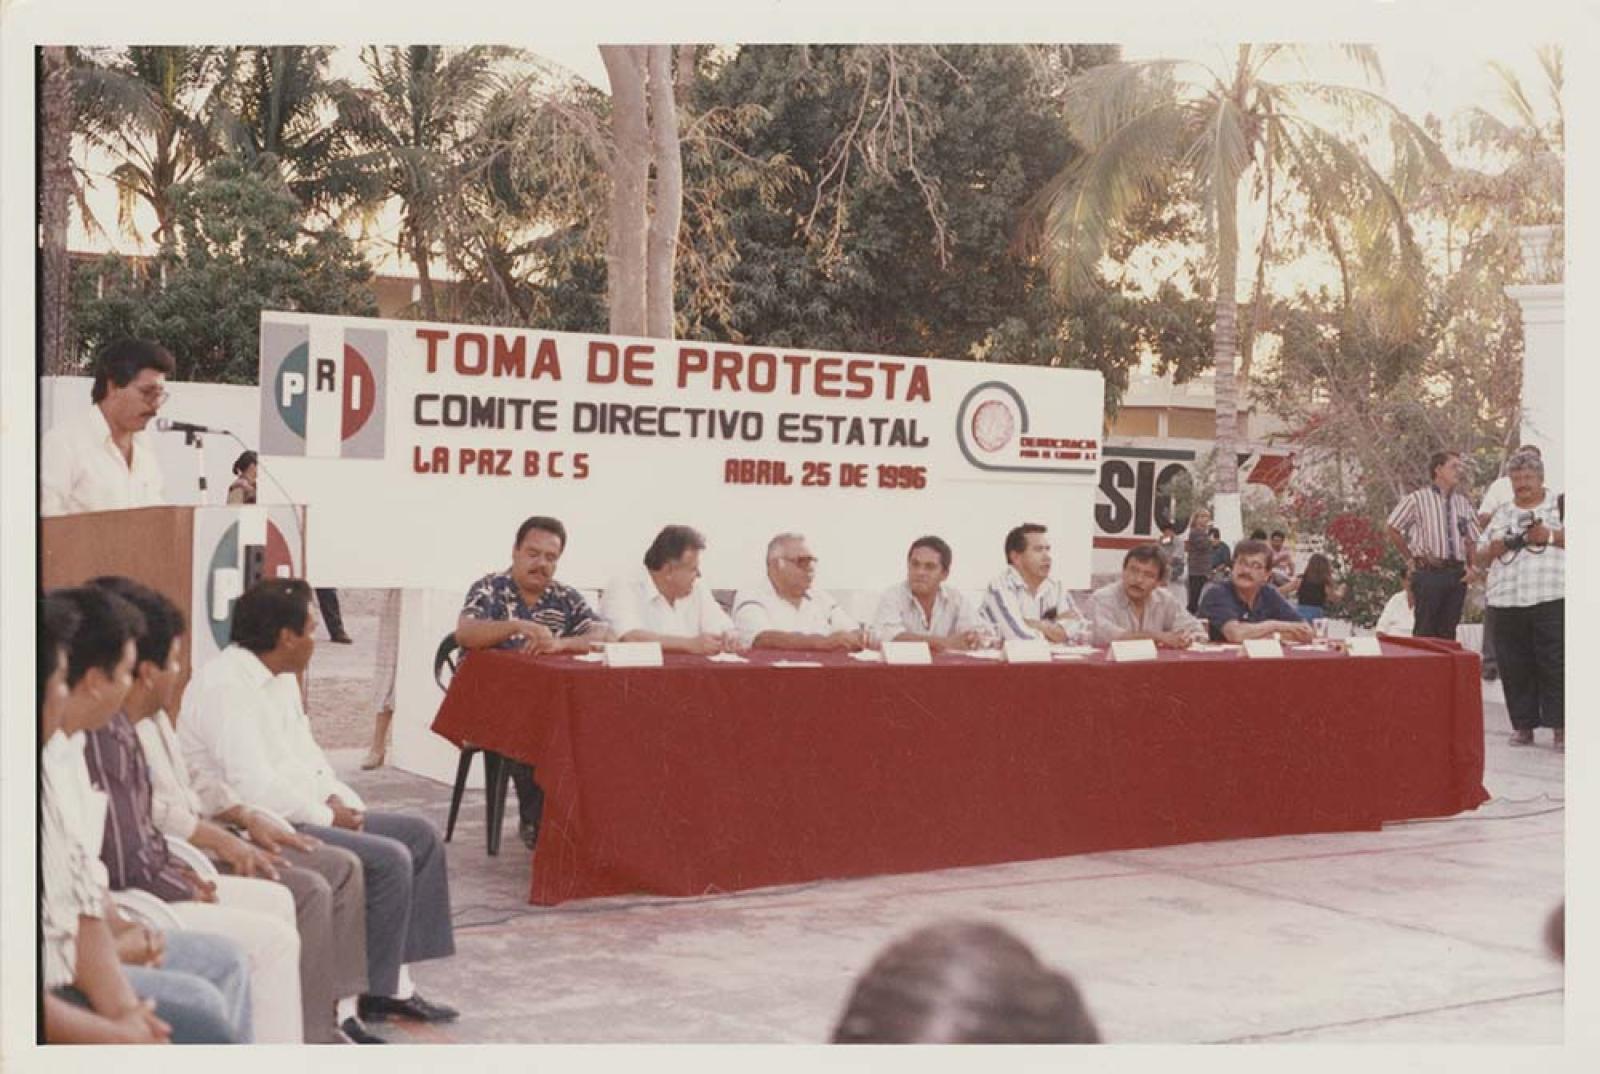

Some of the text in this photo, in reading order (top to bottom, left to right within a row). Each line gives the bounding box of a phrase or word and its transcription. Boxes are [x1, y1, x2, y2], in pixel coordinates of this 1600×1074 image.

[416, 329, 931, 403] TOMA DE PROTESTA
[413, 394, 929, 448] COMITE DIRECTIVO ESTATAL
[413, 446, 450, 474] LA
[459, 448, 512, 476] PAZ
[724, 458, 928, 490] ABRIL 25 DE 1996
